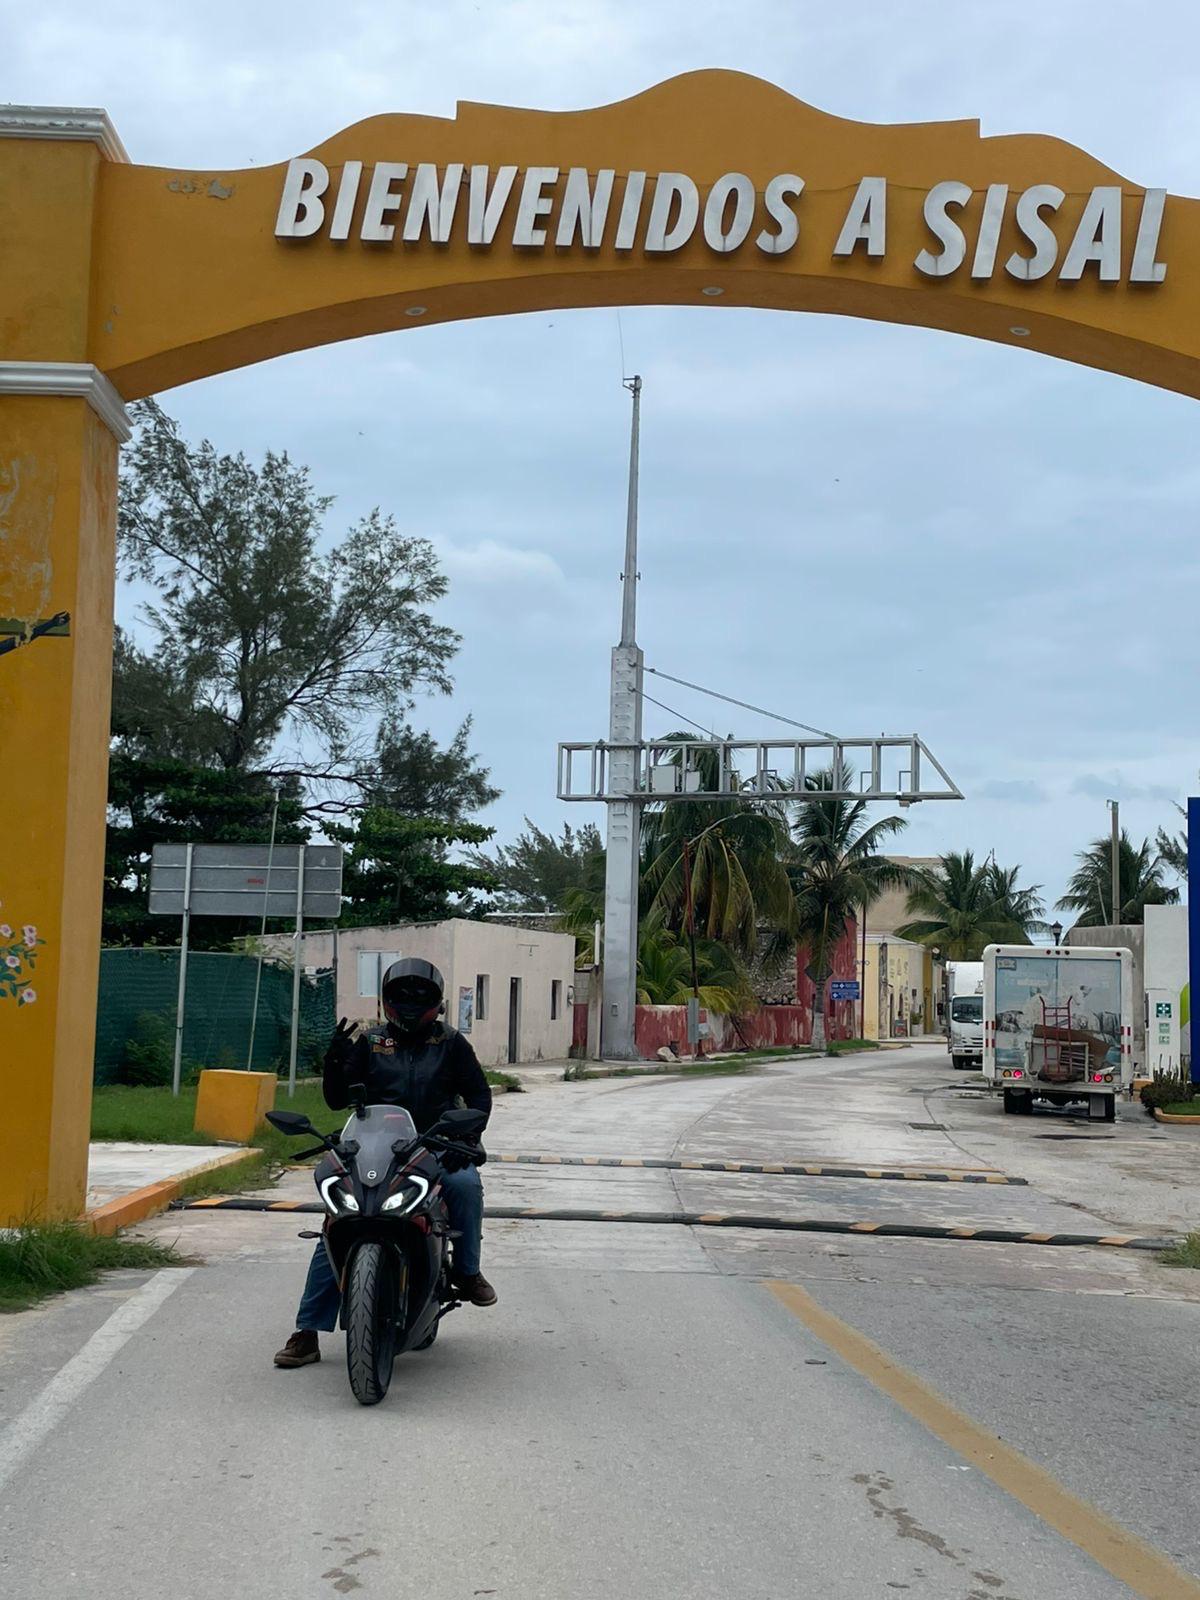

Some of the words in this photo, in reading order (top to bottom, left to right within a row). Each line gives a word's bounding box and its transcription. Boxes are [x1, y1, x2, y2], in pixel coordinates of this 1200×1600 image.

[274, 158, 806, 255] BIENVENIDOS
[832, 176, 887, 257] A
[913, 180, 1168, 283] SISAL
